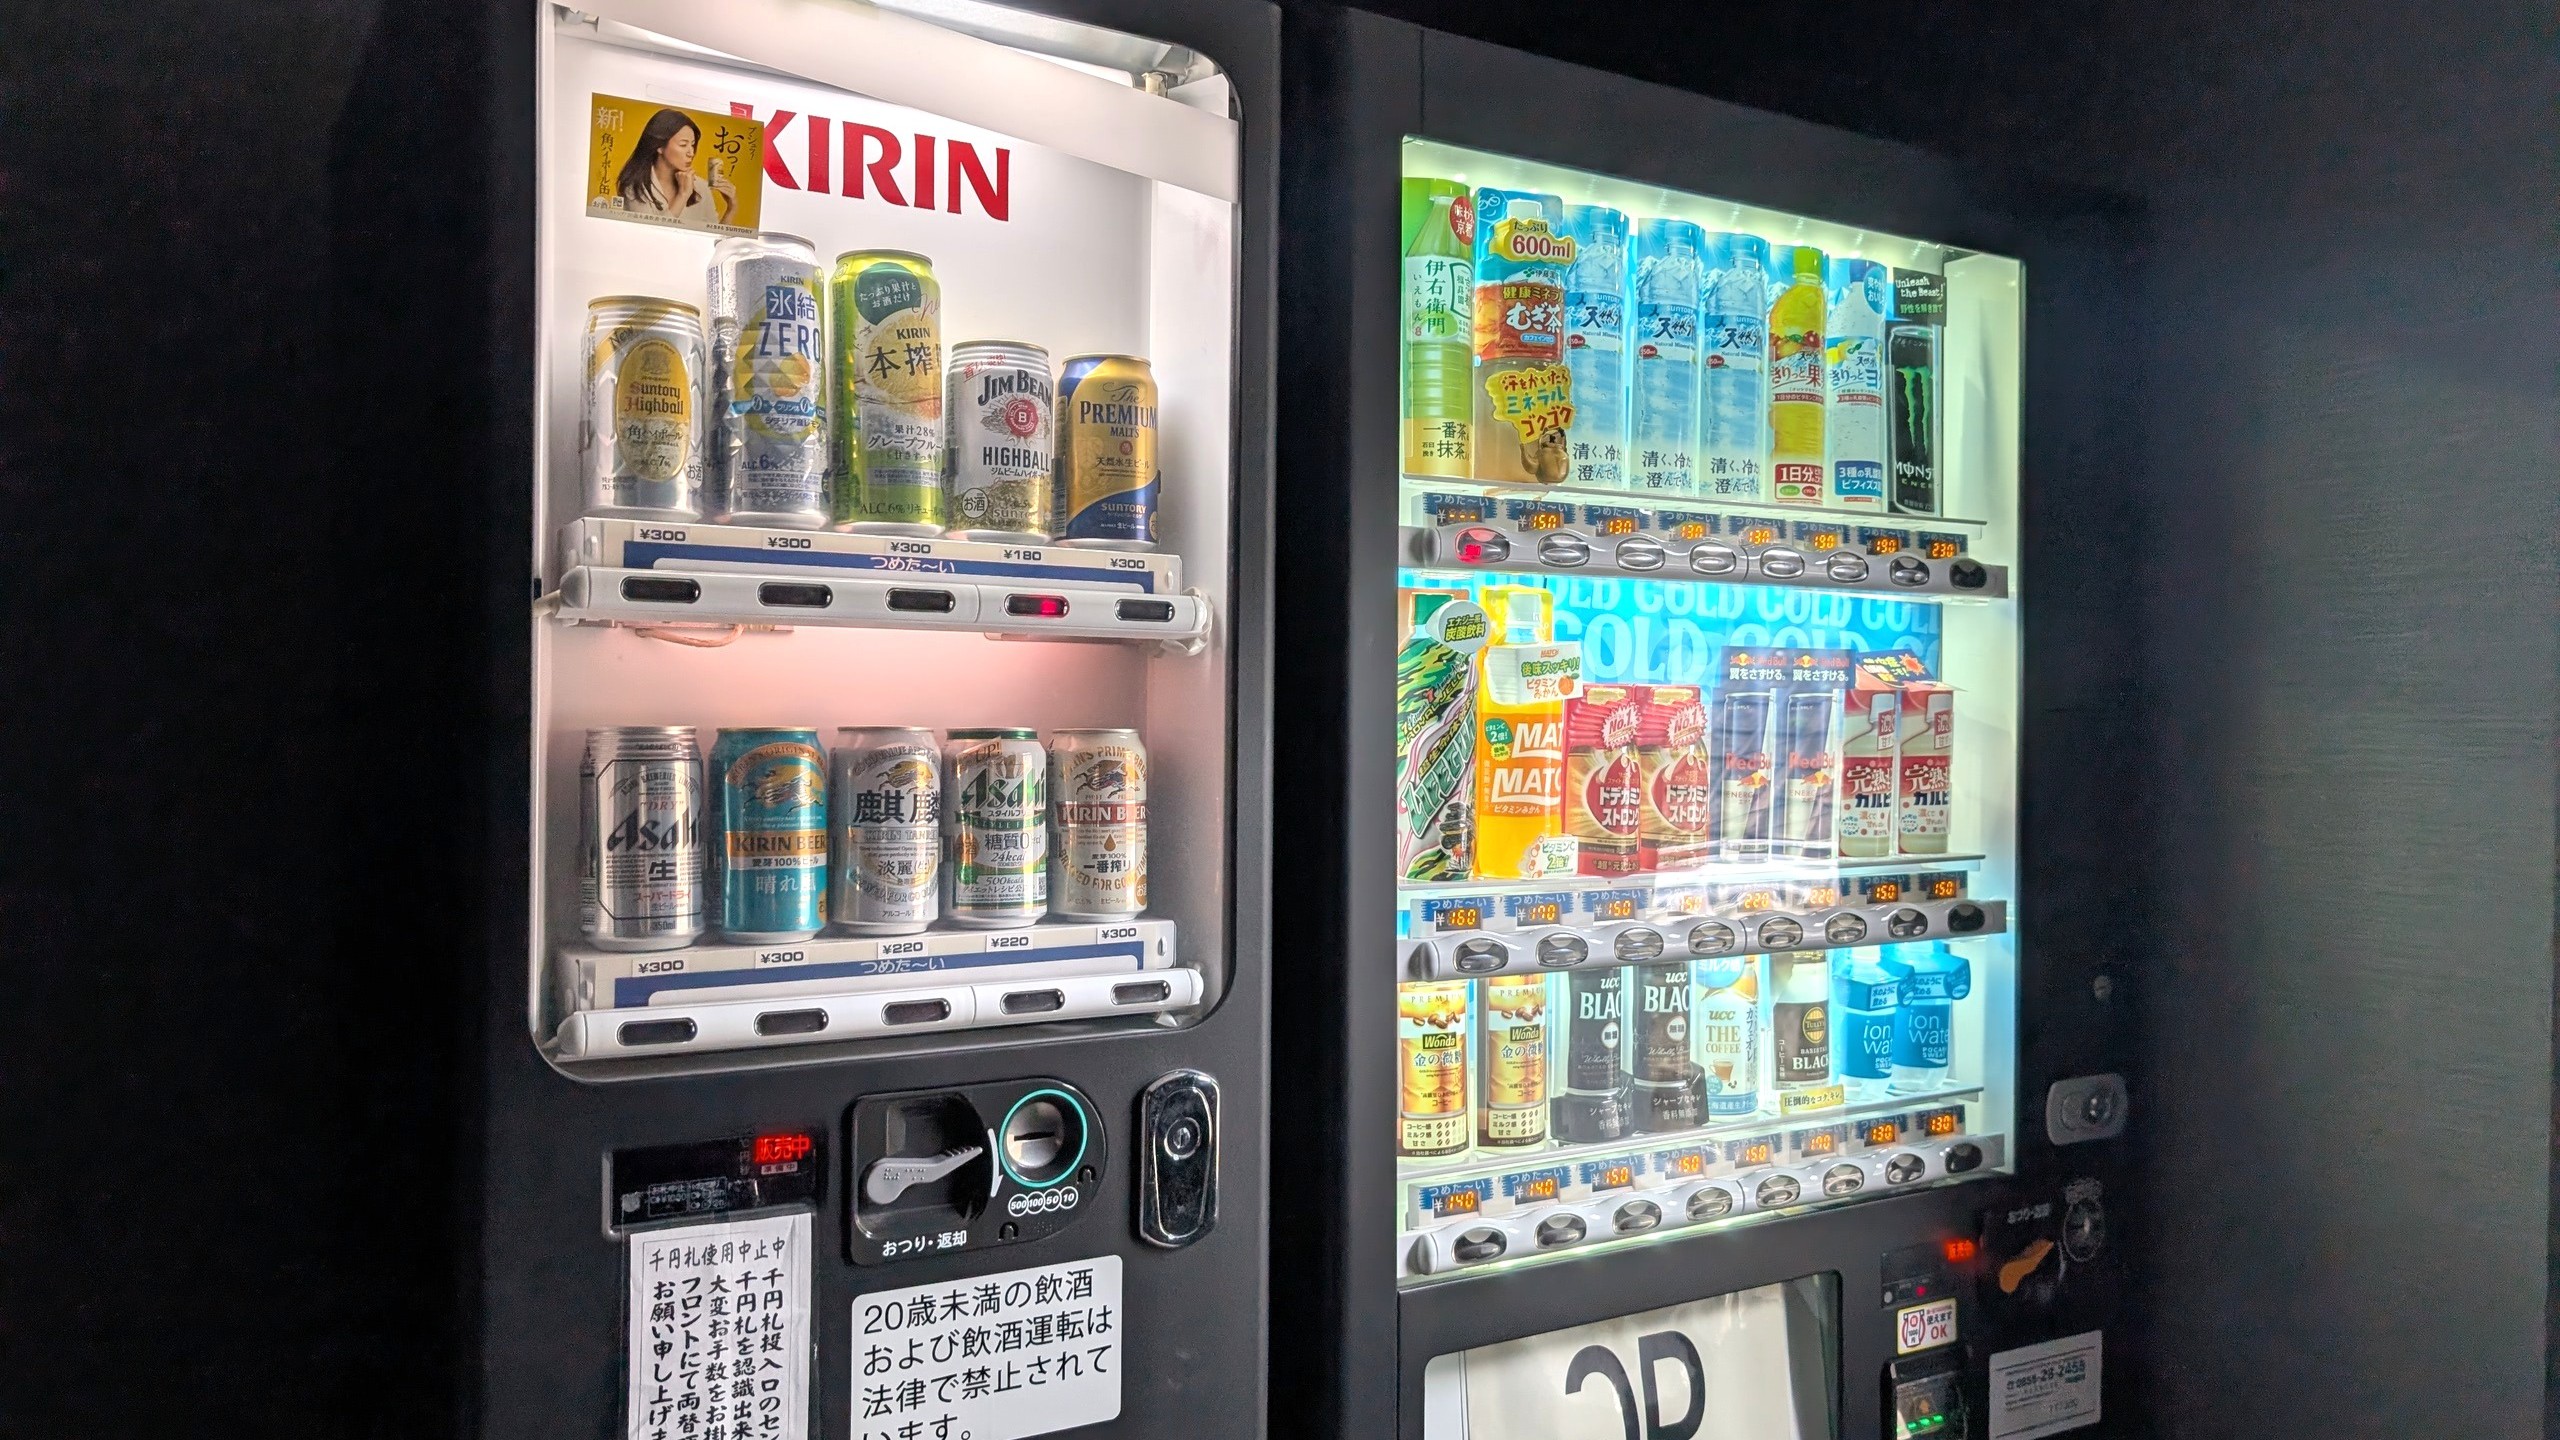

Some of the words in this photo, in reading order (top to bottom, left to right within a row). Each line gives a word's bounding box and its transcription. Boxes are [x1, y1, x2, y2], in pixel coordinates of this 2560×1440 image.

[596, 106, 624, 132] 新!
[713, 126, 744, 177] おっ!
[1513, 221, 1549, 233] たっぷり
[1512, 234, 1571, 259] 600ml
[780, 275, 804, 285] KIRIN
[1895, 276, 1930, 288] Unleash
[872, 293, 911, 309] お酒だけ
[1413, 273, 1423, 322] いえもん
[1425, 259, 1447, 334] 伊右衛門
[1901, 287, 1917, 298] the
[767, 286, 816, 321] 氷結
[1506, 301, 1563, 334] むぎ茶
[608, 326, 635, 348] New
[758, 322, 821, 362] ZERO
[896, 327, 931, 340] KIRIN
[1502, 370, 1569, 391] 汗をかいたら
[1771, 363, 1821, 388] きりっと果
[1831, 368, 1880, 389] きりっとヨ
[630, 381, 680, 400] Suntory
[978, 372, 1015, 407] JIM
[1103, 382, 1145, 404] The
[625, 397, 684, 415] Highball
[1507, 386, 1566, 415] ミネラル
[1080, 401, 1158, 431] PREMIUM
[1521, 406, 1573, 438] ゴクゴク
[627, 424, 683, 440] 角ハイボール
[1110, 426, 1140, 439] MALT'S
[983, 446, 1050, 472] HIGHBALL
[963, 493, 986, 512] お酒
[1101, 503, 1147, 514] SUNTORY
[640, 528, 686, 542] ¥300
[768, 537, 811, 549] ¥300
[890, 541, 931, 554] ¥300
[1003, 549, 1042, 561] ¥180
[1110, 558, 1146, 570] ¥300
[1445, 623, 1486, 640] 炭酸飲料
[1521, 656, 1581, 677] 後味スッキリ!
[1729, 668, 1786, 681] 翼をさずける。
[1793, 669, 1850, 682] 翼をさずける。
[1526, 678, 1557, 689] ビタミン
[1533, 688, 1559, 699] みかん
[962, 768, 1045, 809] Asahi
[1062, 805, 1111, 821] KIRIN
[1116, 805, 1146, 820] BER
[1494, 804, 1540, 814] ビタミンみかん
[735, 835, 792, 851] KIRIN
[796, 834, 826, 850] BEER
[649, 860, 678, 881] 生
[1083, 859, 1131, 874] 一番搾り
[1101, 927, 1137, 938] ¥300
[882, 942, 923, 955] ¥220
[991, 936, 1029, 948] ¥220
[760, 951, 804, 964] ¥300
[638, 960, 684, 974] ¥300
[1908, 1008, 1940, 1030] ion
[1511, 1027, 1540, 1041] Wonda
[1705, 1025, 1741, 1043] THE
[1863, 1019, 1891, 1040] ion
[1424, 1034, 1457, 1049] Wonda
[1705, 1042, 1741, 1054] COFFEE
[755, 1135, 811, 1161] 販売中
[1010, 1199, 1027, 1211] 500
[1028, 1196, 1044, 1208] 100
[1045, 1194, 1060, 1205] 50
[1063, 1192, 1075, 1203] 10
[882, 1230, 968, 1257] おつり・返却
[649, 1236, 786, 1273] 千円札使用中止中
[864, 1268, 1094, 1335] 20歳未満の飲酒
[863, 1305, 1113, 1377] および飲酒運転は
[1930, 1325, 1948, 1340] OK
[676, 1276, 703, 1440] フロントにて両替
[862, 1344, 1112, 1420] 法律で禁止されて
